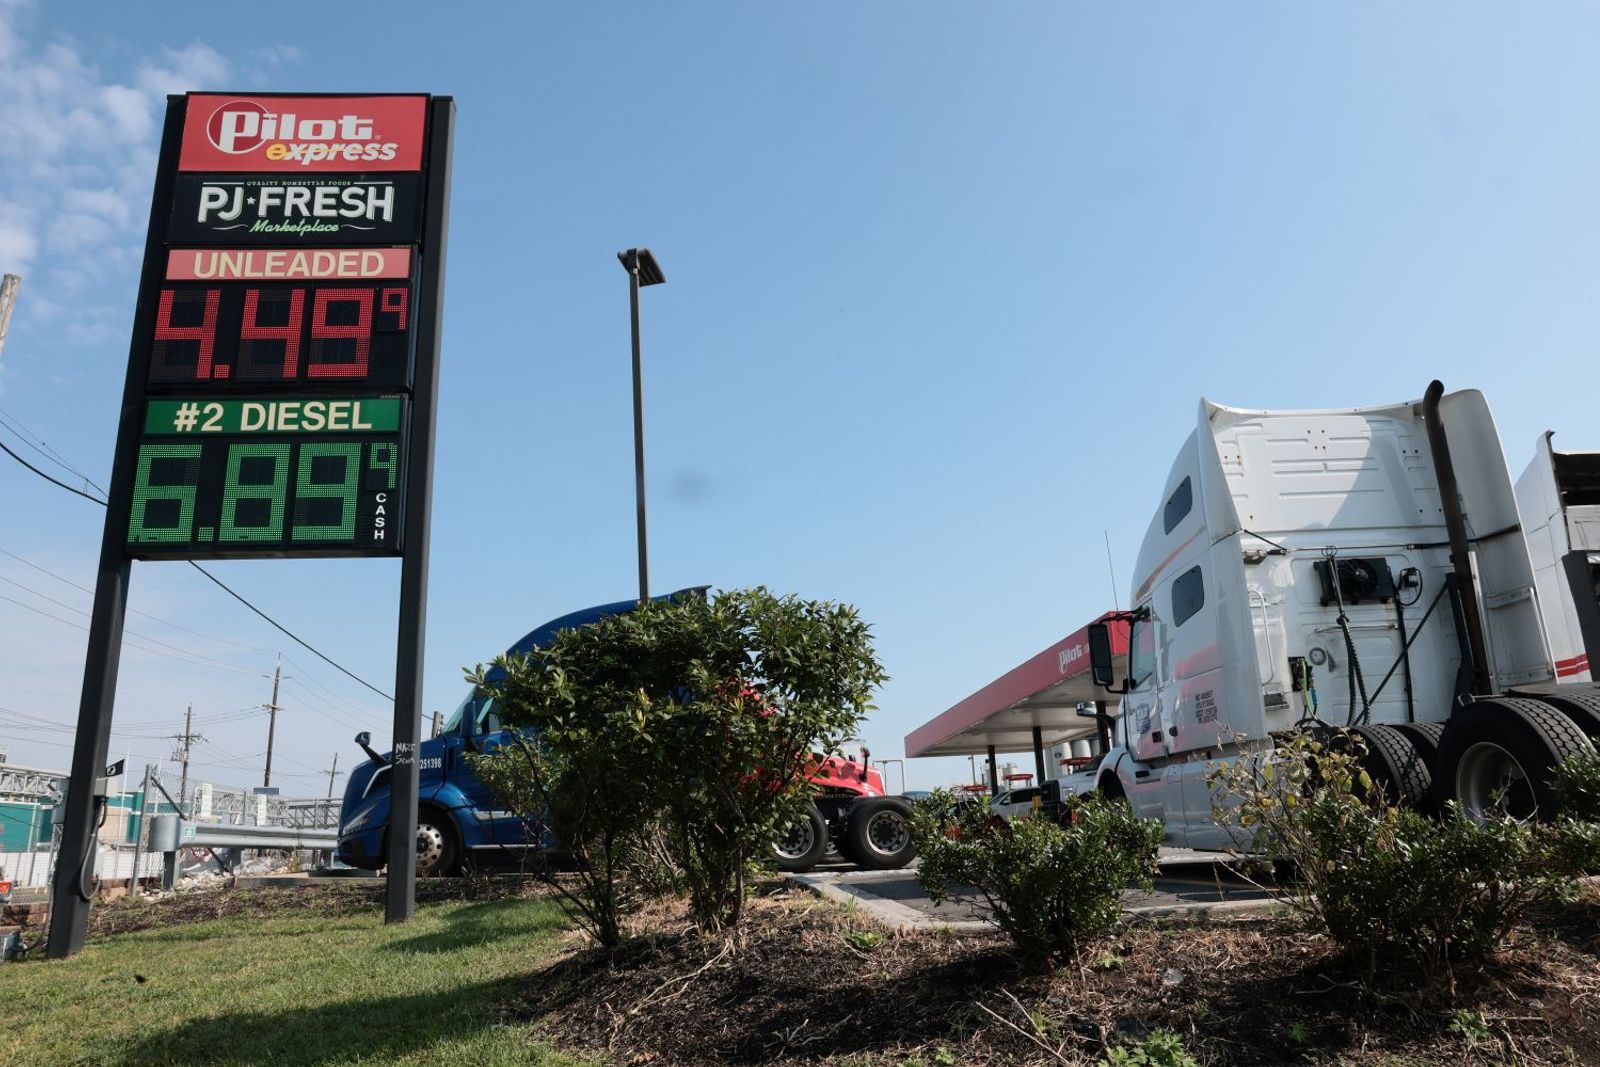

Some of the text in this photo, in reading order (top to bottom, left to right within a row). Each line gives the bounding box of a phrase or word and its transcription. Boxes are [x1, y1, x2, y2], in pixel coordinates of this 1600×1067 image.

[218, 111, 373, 151] Pilot
[265, 141, 398, 165] express
[197, 186, 394, 223] PJ FRESH
[249, 218, 340, 237] Marketplace
[193, 250, 385, 278] UNLEADED
[173, 401, 372, 432] #2 DIESEL
[373, 492, 388, 540] CASH
